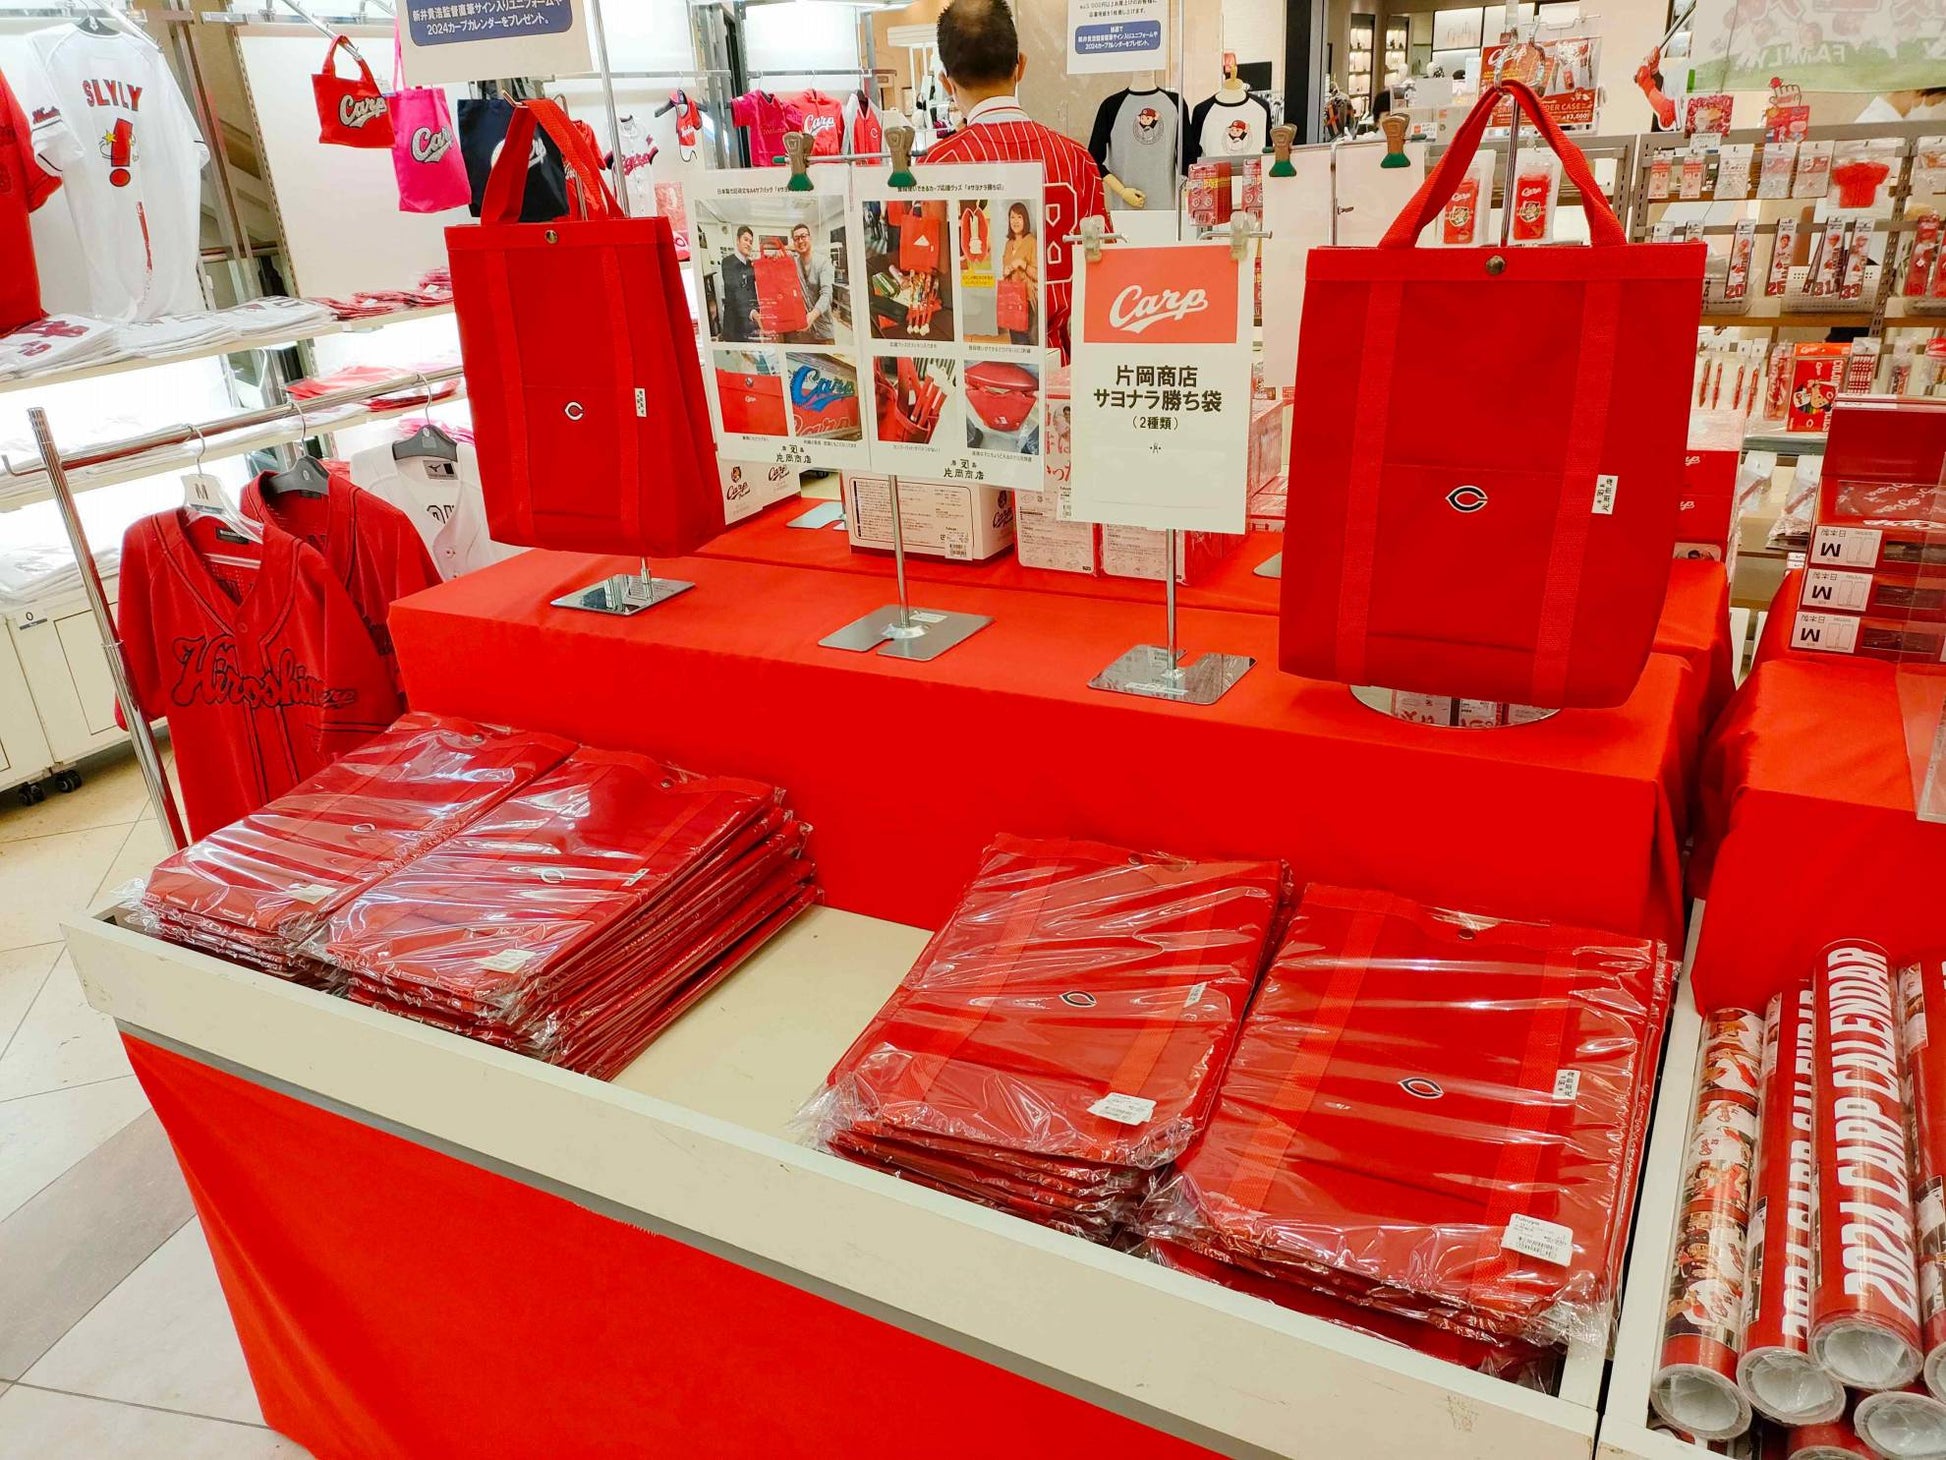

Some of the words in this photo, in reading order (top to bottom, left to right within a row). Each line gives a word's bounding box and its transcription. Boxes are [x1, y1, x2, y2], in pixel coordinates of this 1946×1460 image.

[426, 12, 550, 36] 2024カープカレンダーをプレゼント。
[82, 79, 143, 111] SLYLY
[339, 94, 388, 128] Carp
[1109, 284, 1209, 334] Carp
[1116, 365, 1198, 388] 片岡商店
[1093, 389, 1223, 413] サヨナラ勝ち袋
[1820, 542, 1841, 557] M
[1811, 585, 1832, 600] M
[1800, 627, 1820, 642] M
[1827, 946, 1901, 1103] CALENDAR
[1834, 1097, 1910, 1209] CARP
[1841, 1201, 1919, 1321] 2024
